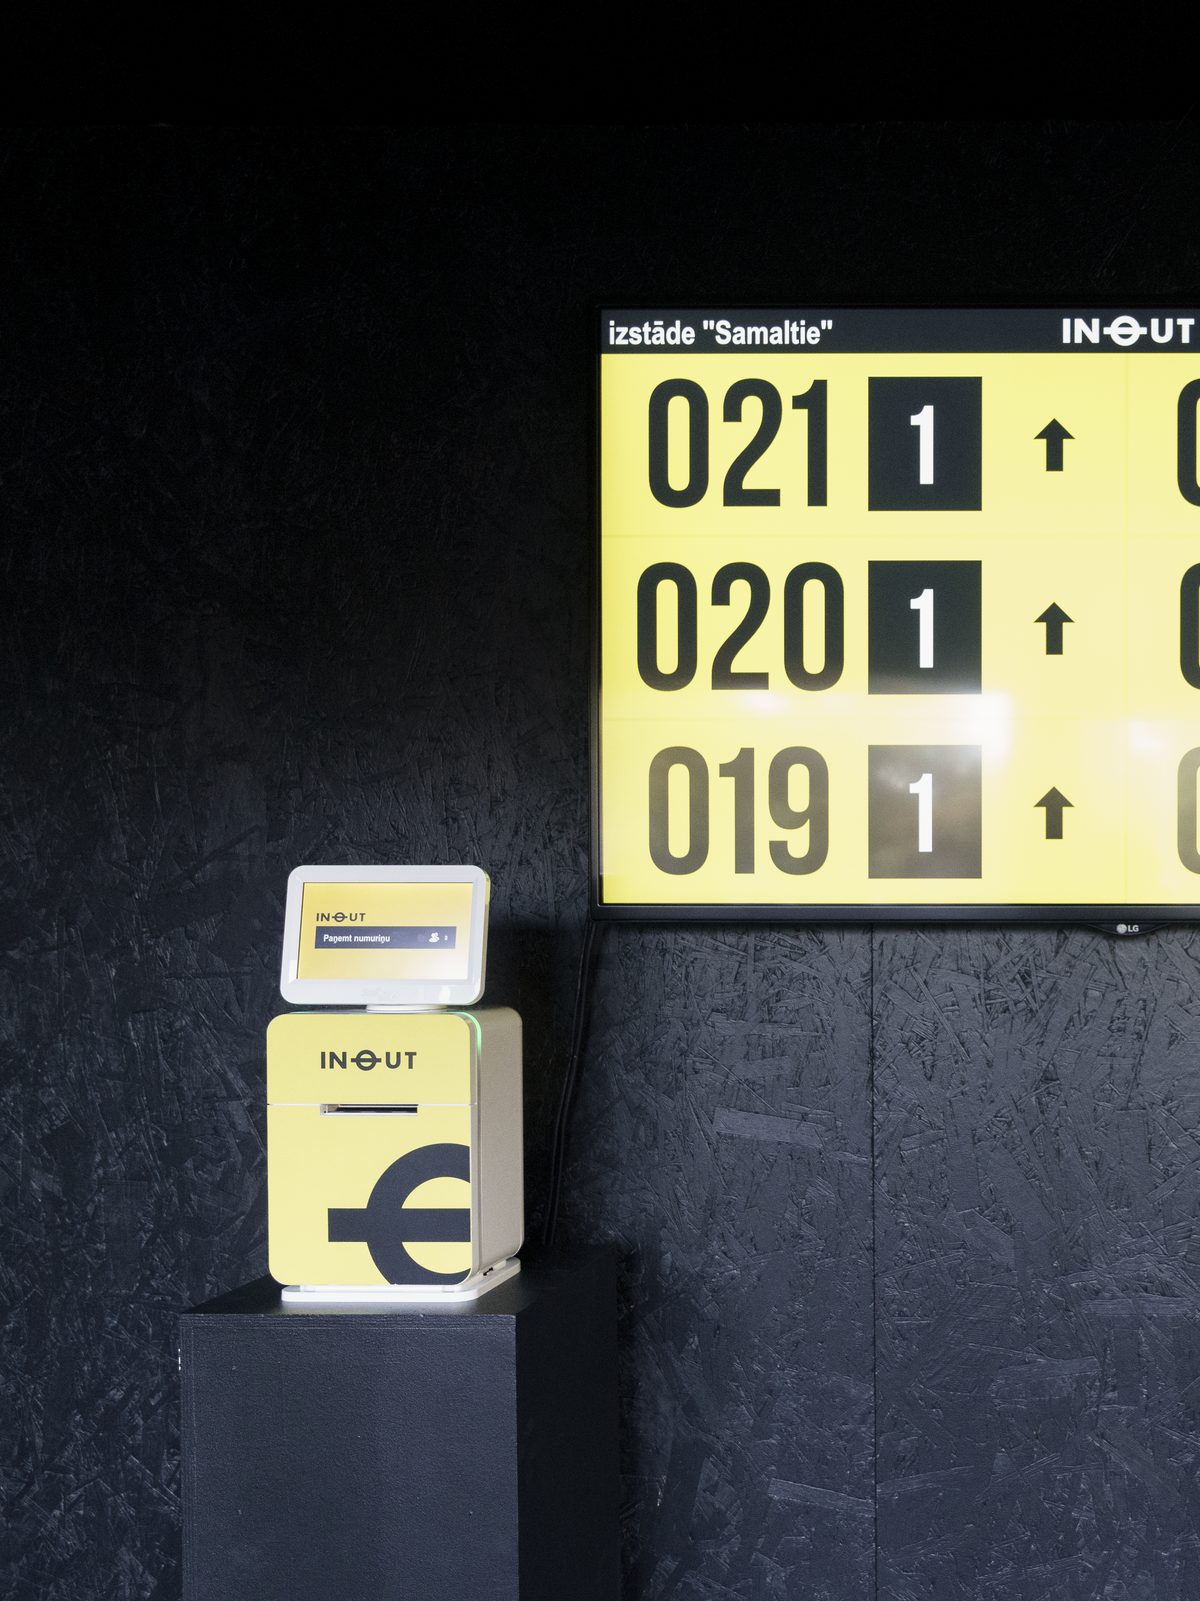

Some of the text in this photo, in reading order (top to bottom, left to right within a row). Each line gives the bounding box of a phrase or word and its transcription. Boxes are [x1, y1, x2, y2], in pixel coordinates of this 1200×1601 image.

[609, 319, 833, 346] izstāde "Samaltie"
[648, 377, 934, 509] 021 1
[636, 561, 934, 693] 020 1
[648, 745, 934, 876] 019 1
